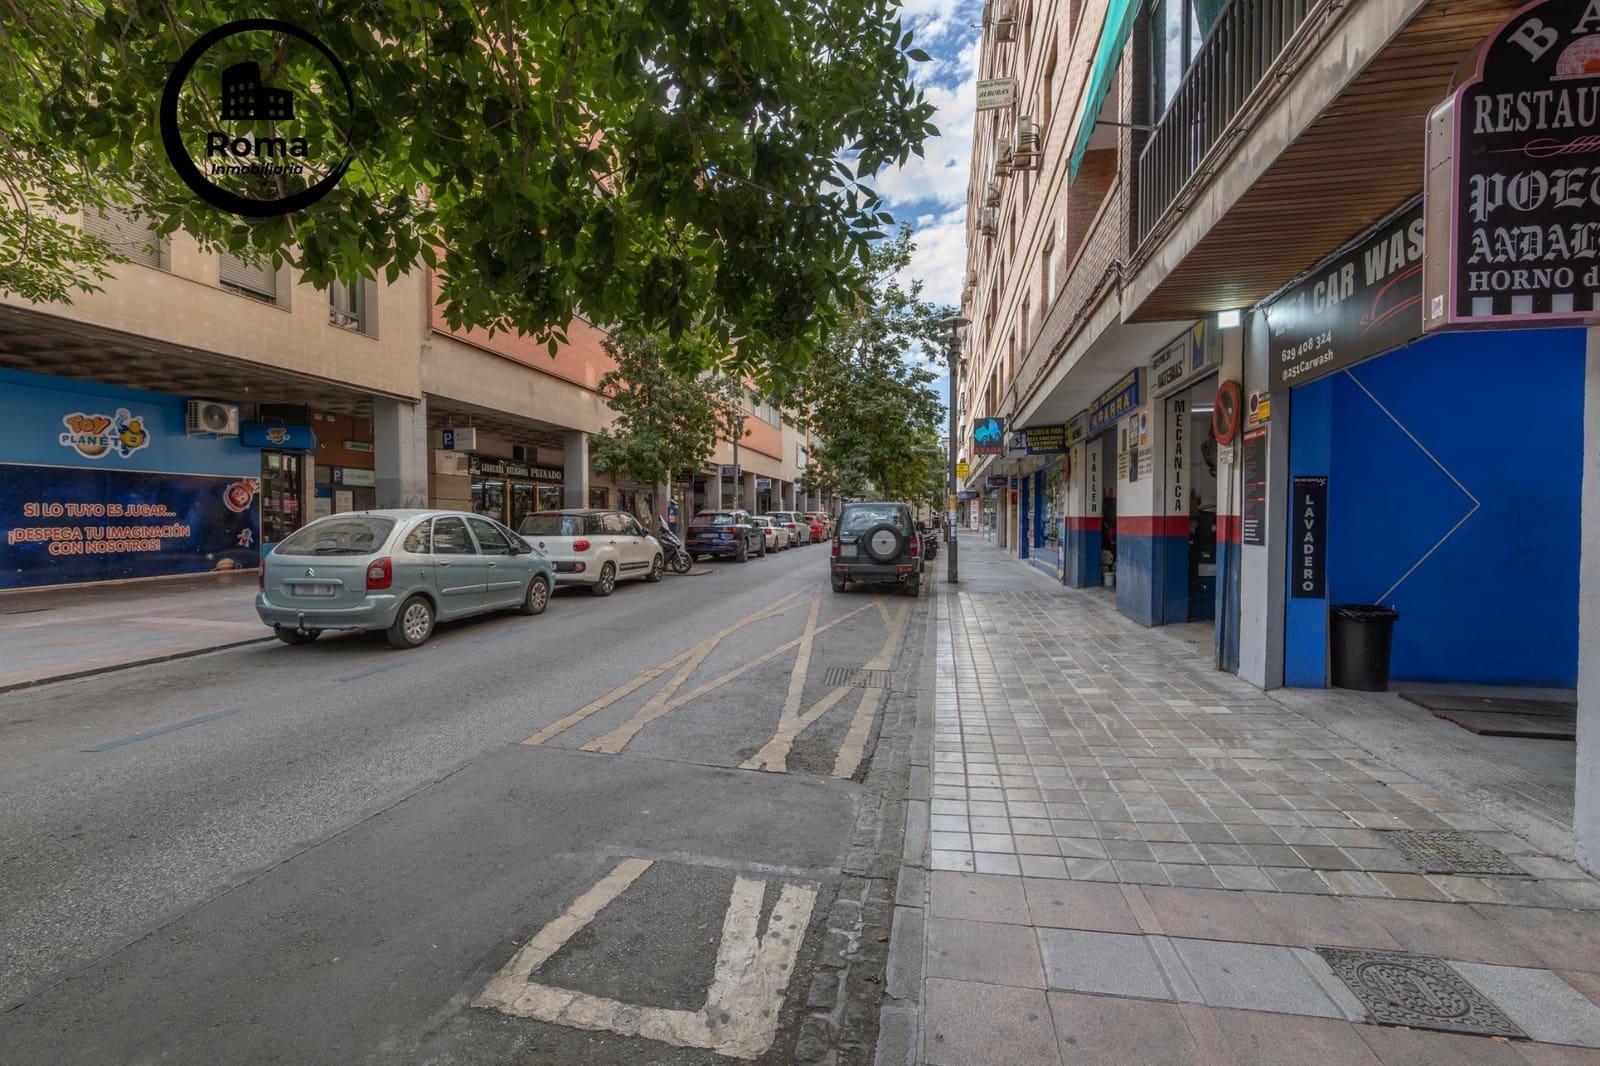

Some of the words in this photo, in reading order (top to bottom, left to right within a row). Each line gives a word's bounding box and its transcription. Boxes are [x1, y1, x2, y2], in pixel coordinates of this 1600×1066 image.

[1468, 166, 1600, 223] POE
[1467, 222, 1600, 264] ANDAL
[1313, 262, 1355, 315] CAR
[1364, 217, 1424, 287] WAS
[1468, 267, 1574, 291] HORNO
[1281, 347, 1296, 362] 629
[1297, 337, 1314, 357] 408
[1315, 329, 1332, 349] 324
[1282, 348, 1334, 381] @251Carwash
[66, 414, 112, 435] TOY
[444, 432, 453, 445] P
[1174, 400, 1185, 512] MECANICA
[334, 469, 341, 481] P
[530, 468, 562, 479] PEINADO
[24, 503, 39, 516] SI
[42, 503, 64, 516] LO
[66, 504, 105, 516] TUYO
[107, 504, 122, 516] ES
[125, 504, 176, 516] JUGAR...
[8, 527, 82, 545] ¡DESPEGA
[86, 527, 103, 539] TU
[107, 523, 190, 538] IMAGINACIÓN
[1302, 495, 1314, 591] LAVADERO
[49, 541, 83, 554] CON
[86, 539, 160, 553] NOSOTROS!
